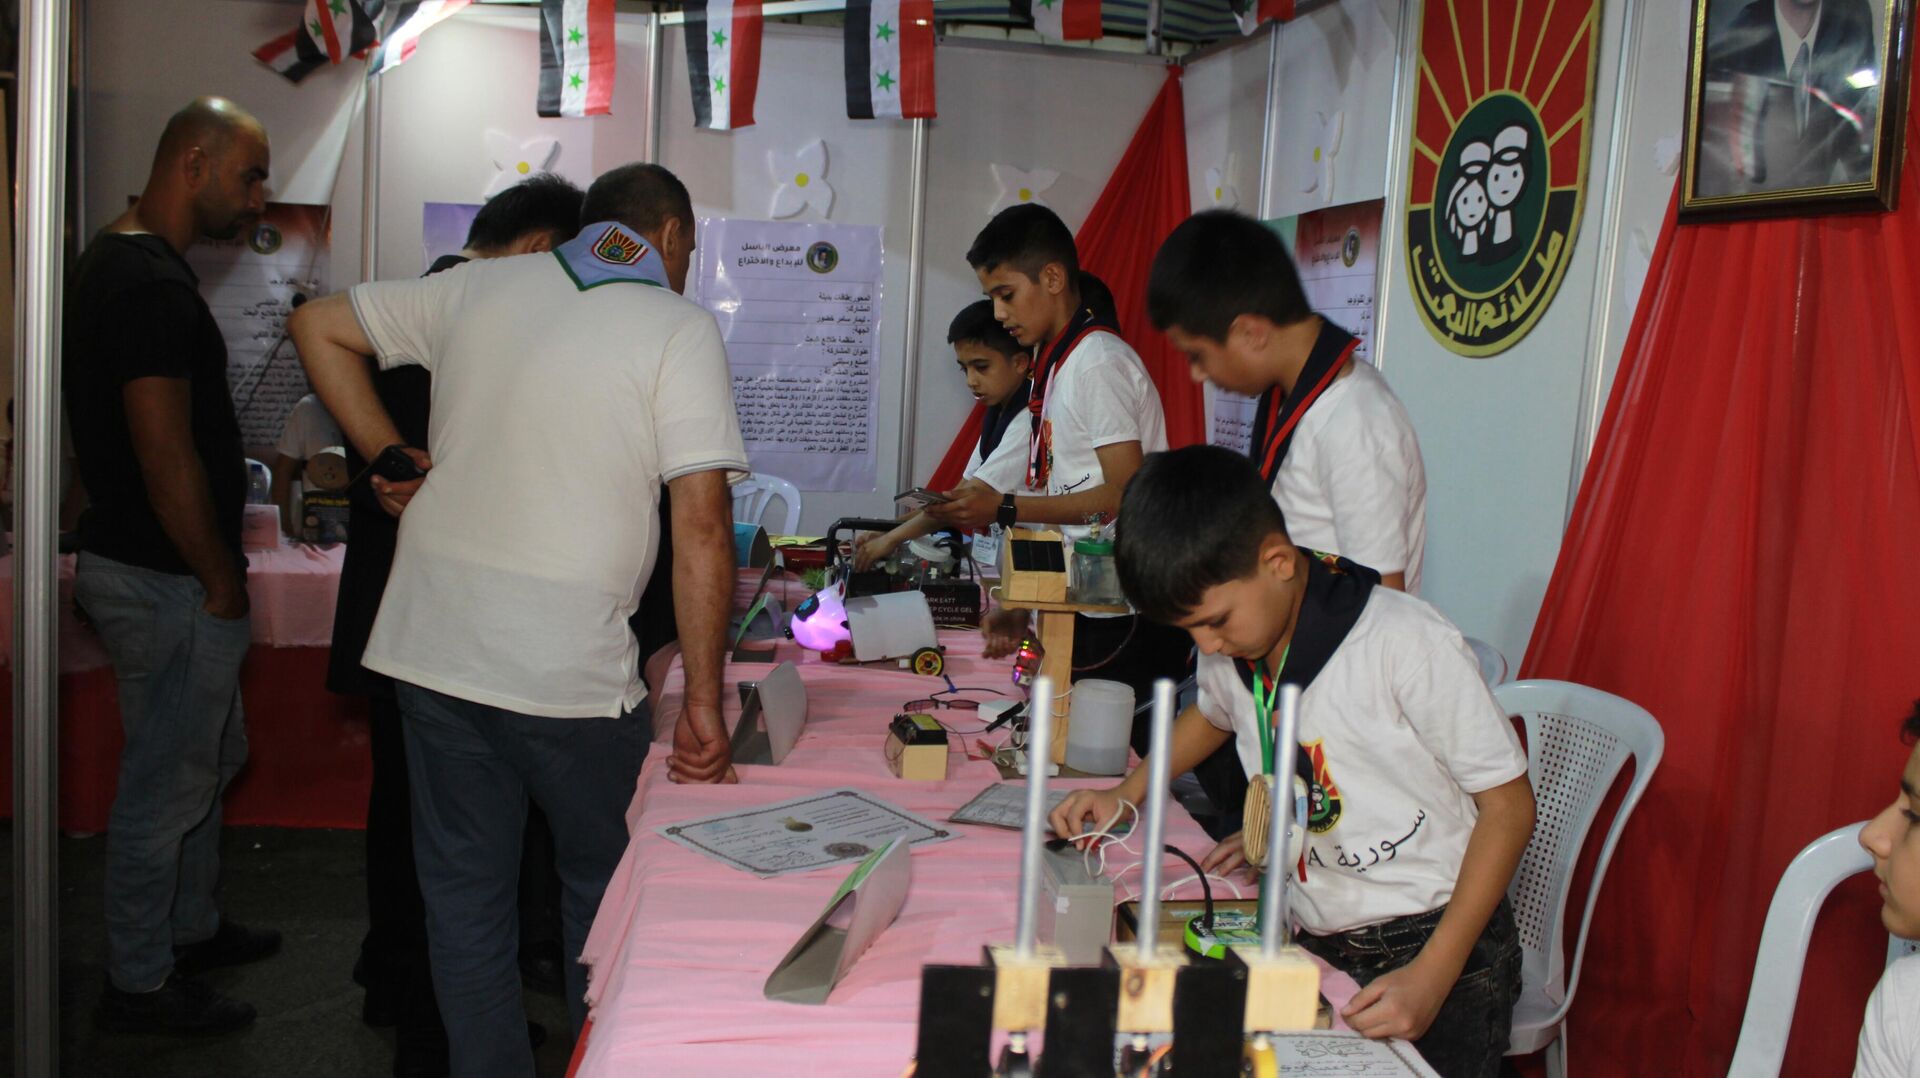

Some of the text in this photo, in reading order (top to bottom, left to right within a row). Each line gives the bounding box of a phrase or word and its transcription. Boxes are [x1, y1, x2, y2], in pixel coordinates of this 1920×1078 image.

[772, 243, 801, 252] معرض
[1474, 230, 1564, 338] طلائع
[1412, 245, 1477, 341] البعث
[1335, 808, 1427, 873] سورية
